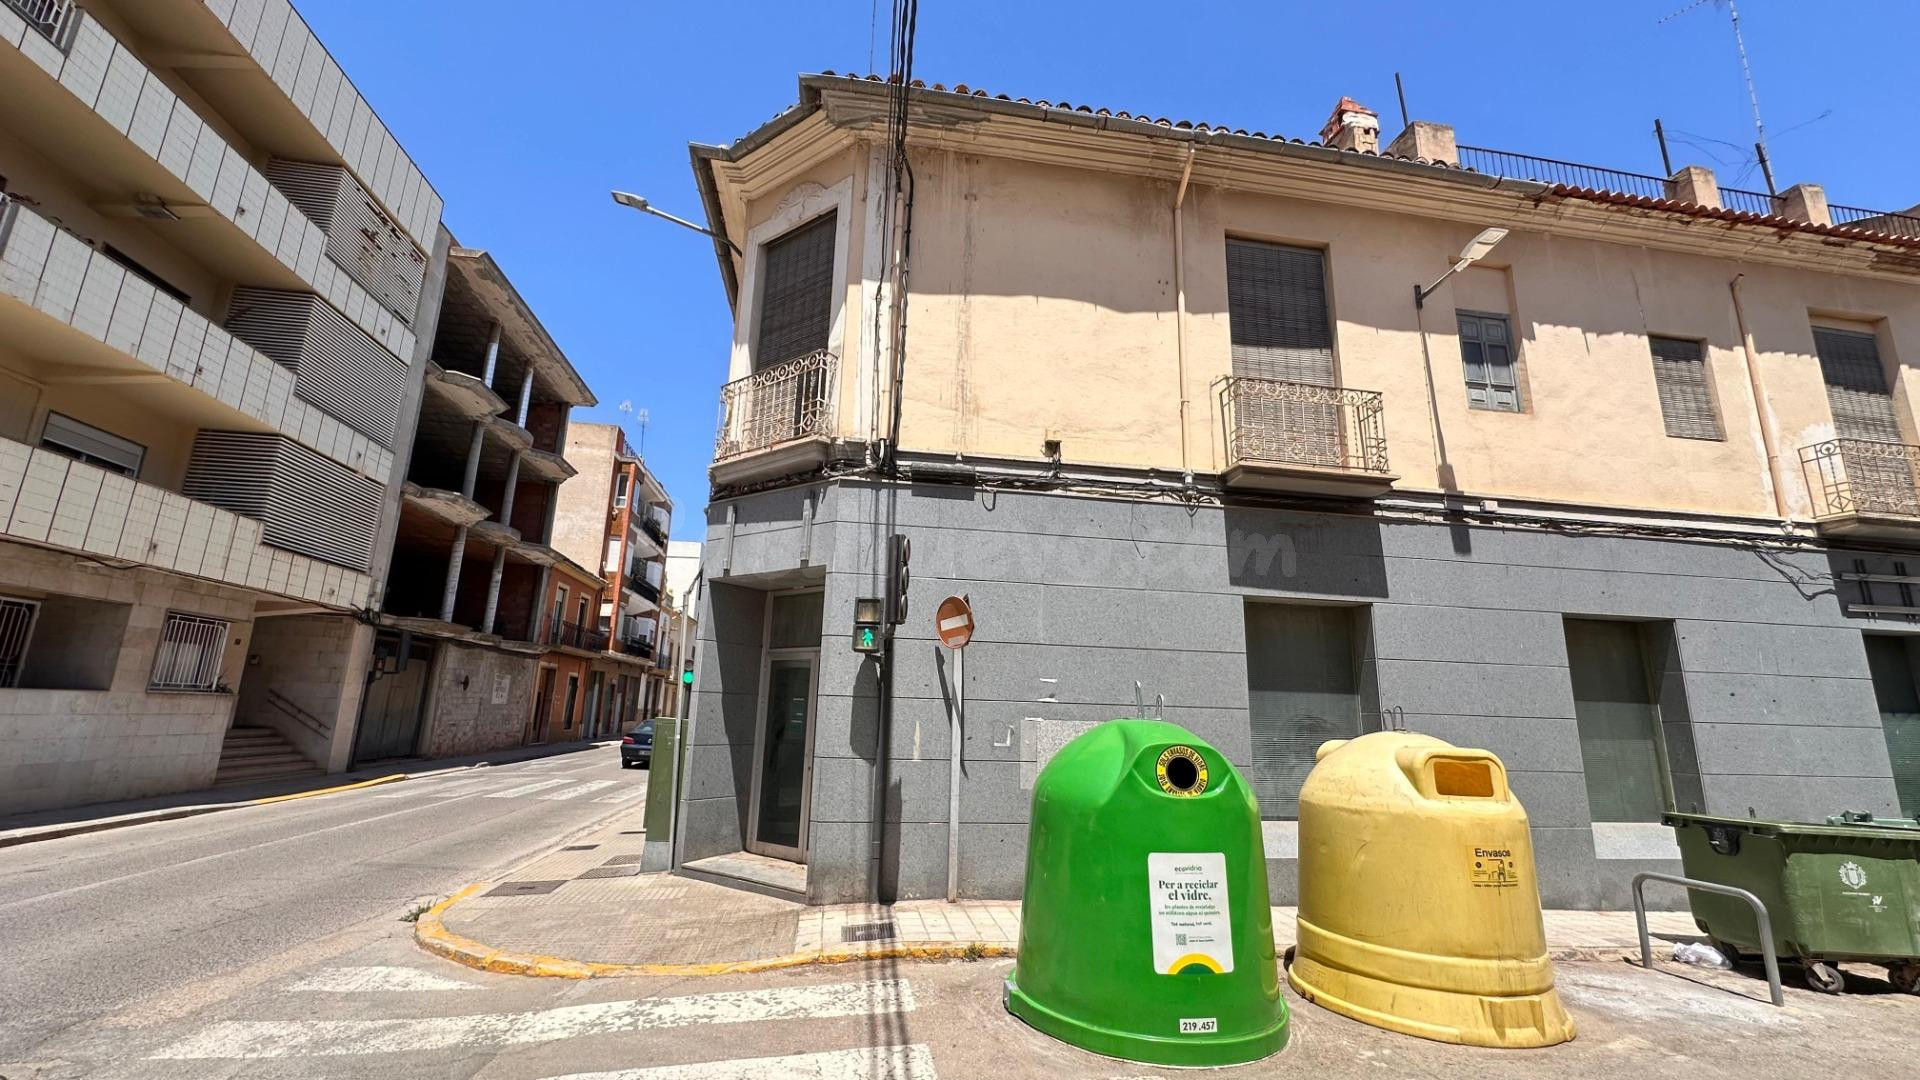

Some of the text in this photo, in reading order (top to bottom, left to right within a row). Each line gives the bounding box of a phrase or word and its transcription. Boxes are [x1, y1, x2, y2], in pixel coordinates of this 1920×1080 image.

[1475, 848, 1511, 858] Envasos
[1158, 880, 1175, 889] Per
[1185, 880, 1219, 889] reciclar
[1168, 889, 1212, 901] el vidre.
